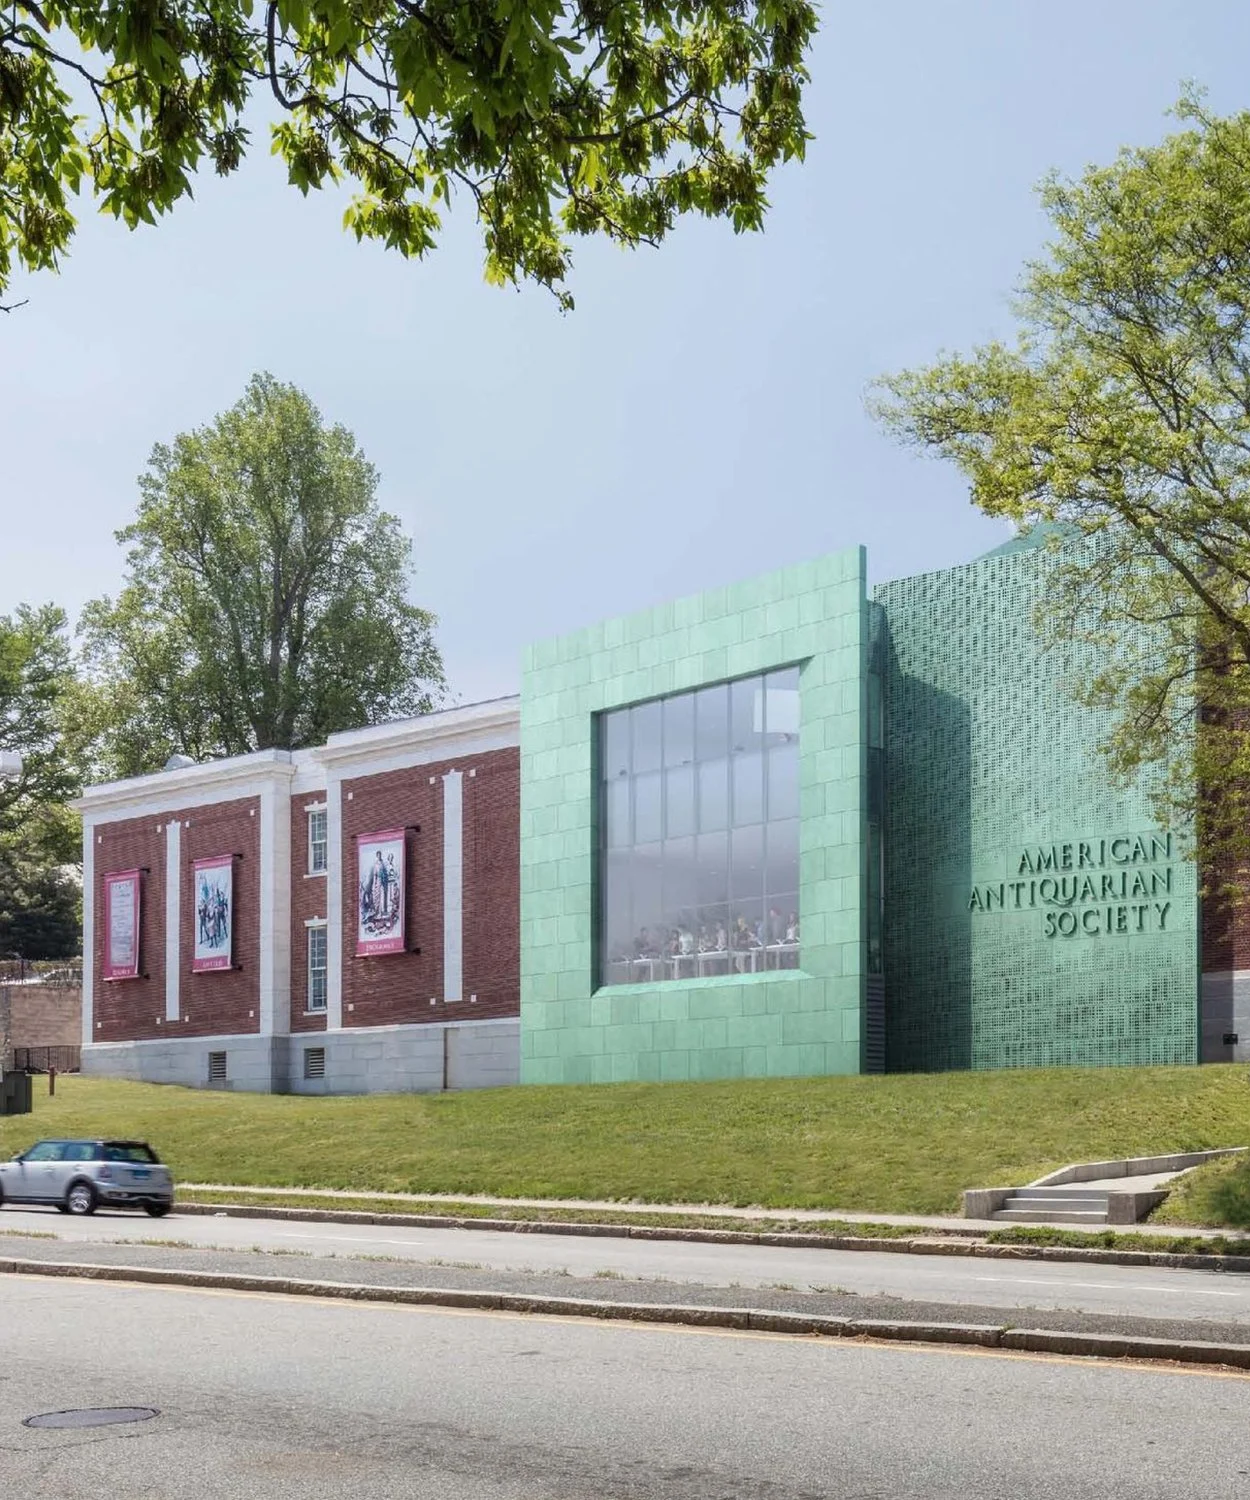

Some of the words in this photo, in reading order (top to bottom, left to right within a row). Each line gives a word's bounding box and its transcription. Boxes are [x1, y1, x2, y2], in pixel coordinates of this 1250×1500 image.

[1018, 832, 1173, 875] AMERICAN
[968, 868, 1172, 912] ANTIQUARIAN
[1044, 902, 1171, 938] SOCIETY
